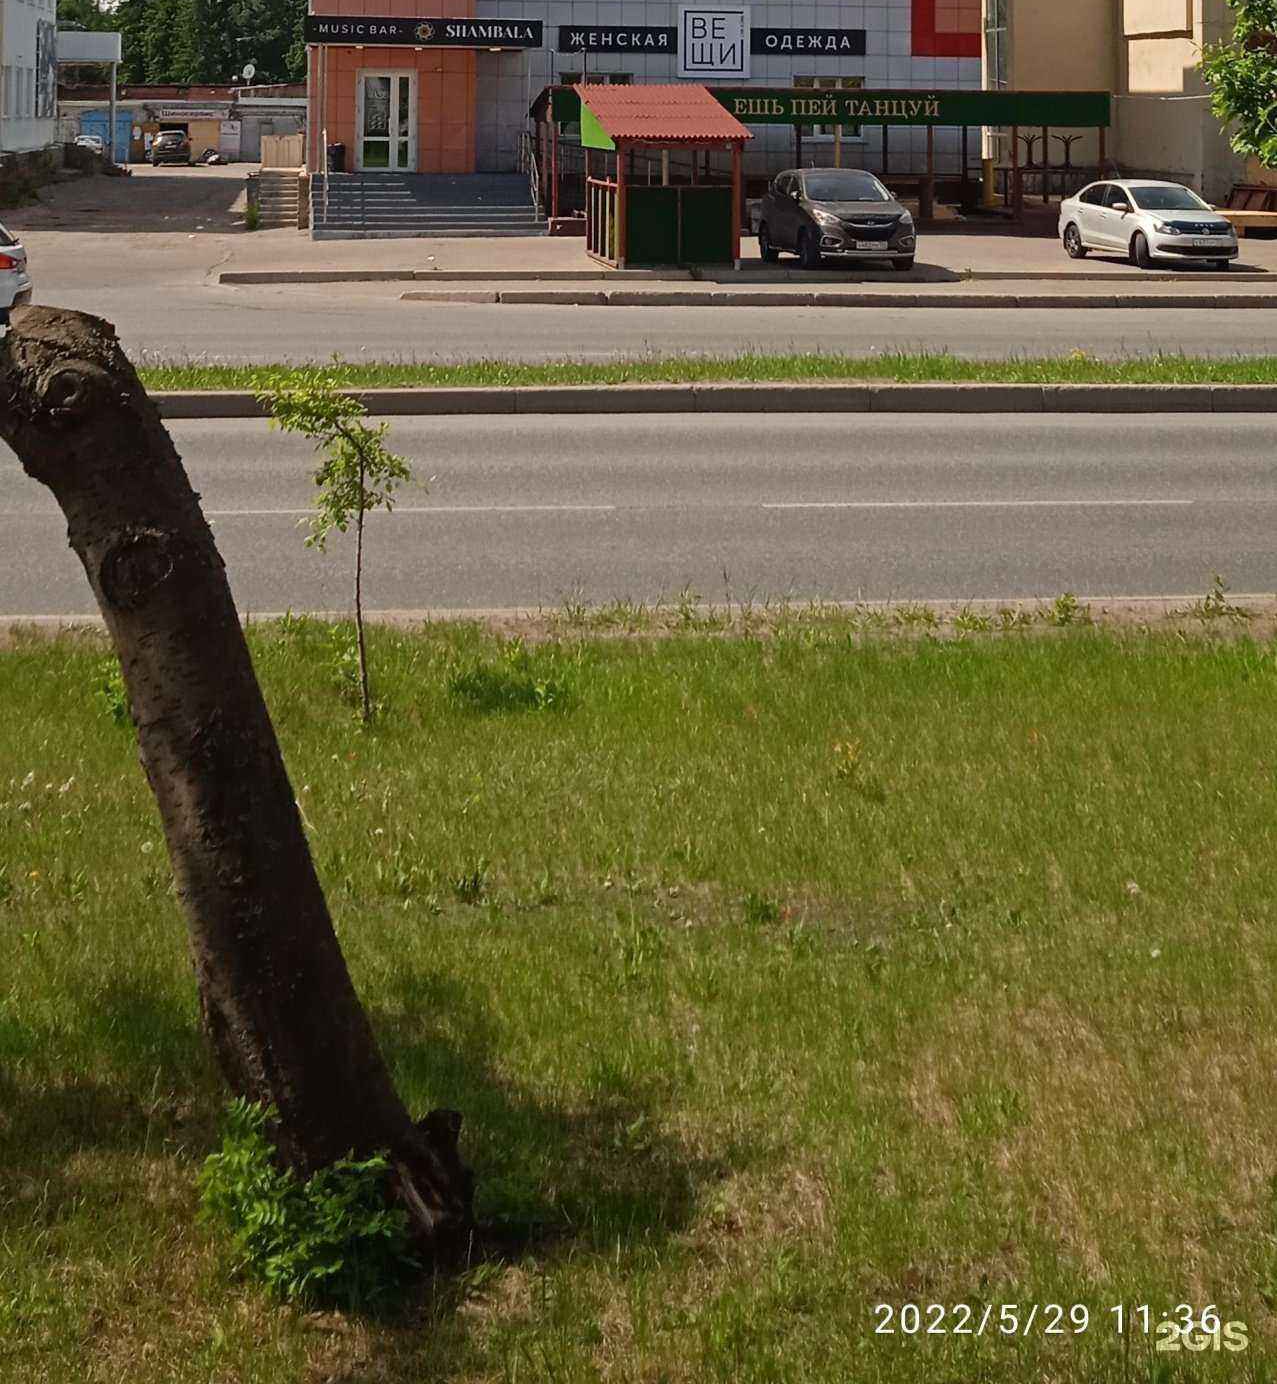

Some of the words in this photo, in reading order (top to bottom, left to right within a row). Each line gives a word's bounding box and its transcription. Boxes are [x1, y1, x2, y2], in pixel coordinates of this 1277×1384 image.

[319, 23, 364, 34] MUSIC
[369, 25, 397, 35] BAR
[446, 25, 534, 39] SHAMBALA
[692, 17, 725, 39] ВЕ
[570, 31, 668, 47] ЖЕНСКАЯ
[765, 34, 850, 50] ОДЕЖДА
[692, 43, 736, 66] ЩИ
[734, 98, 784, 116] ЕШЬ
[790, 94, 837, 116] ПЕЙ
[844, 94, 940, 119] ТАНЦУЙ
